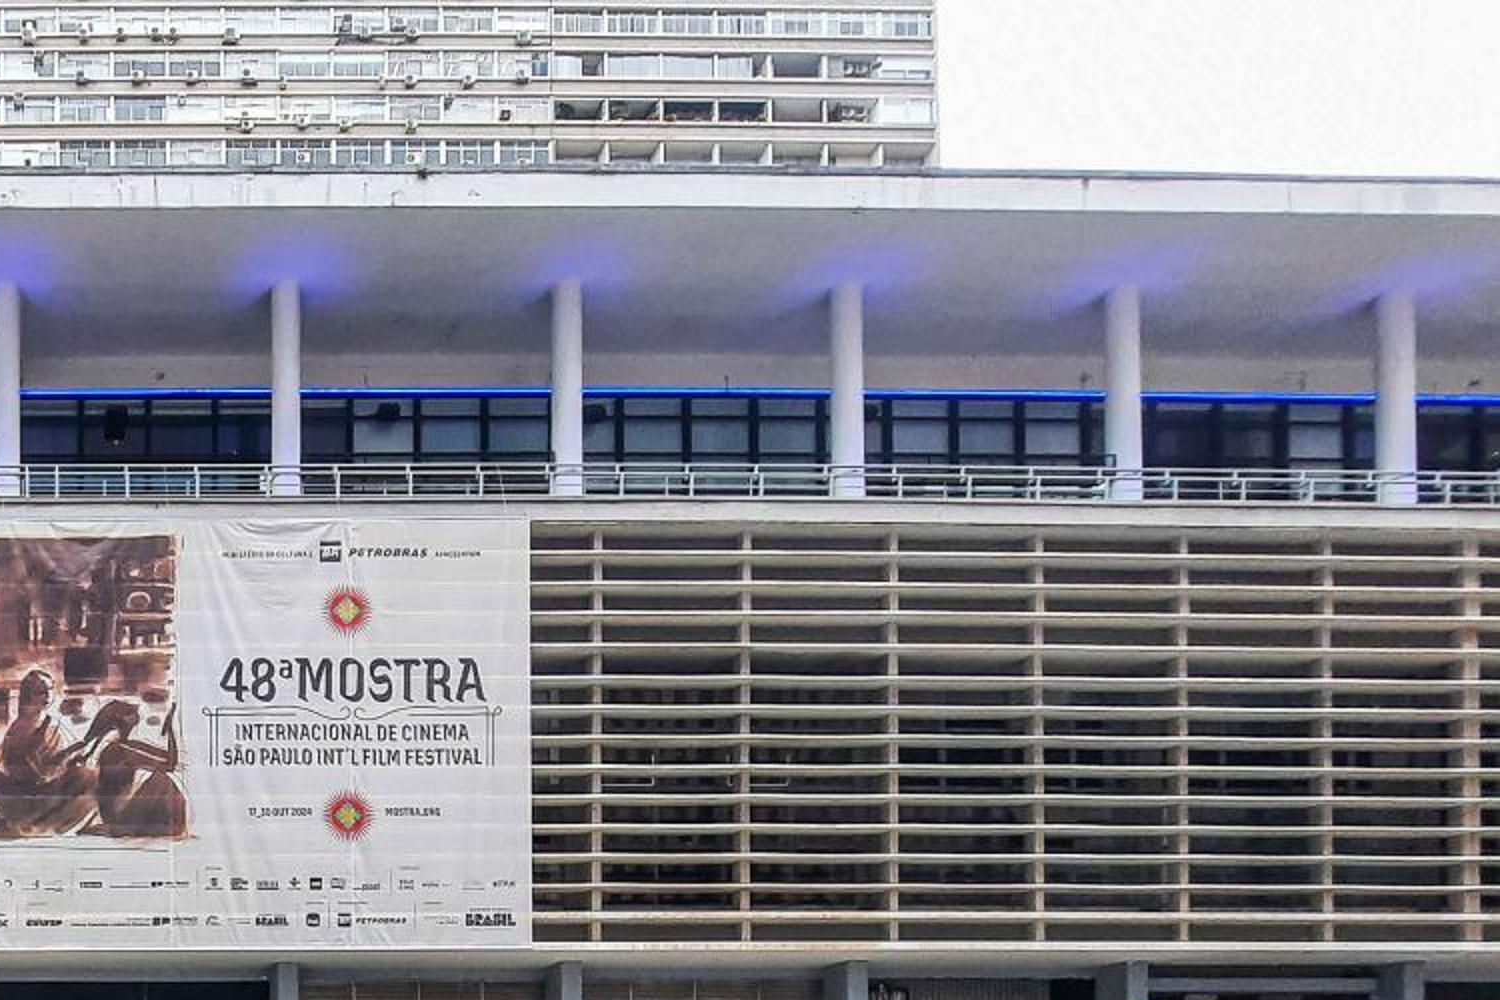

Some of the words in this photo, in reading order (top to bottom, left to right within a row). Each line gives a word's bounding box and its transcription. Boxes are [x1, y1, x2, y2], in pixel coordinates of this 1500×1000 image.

[349, 547, 428, 559] PETROBRAS
[294, 657, 487, 703] MOSTRA
[235, 723, 373, 741] INTERNACIONAL
[377, 723, 397, 741] DE
[401, 723, 469, 741] CINEMA
[223, 743, 255, 765] SÃO
[260, 748, 312, 765] PAULO
[316, 747, 359, 765] INT'L
[362, 748, 401, 765] FILM
[405, 748, 483, 765] FESTIVAL
[355, 917, 407, 925] PETROBRAS
